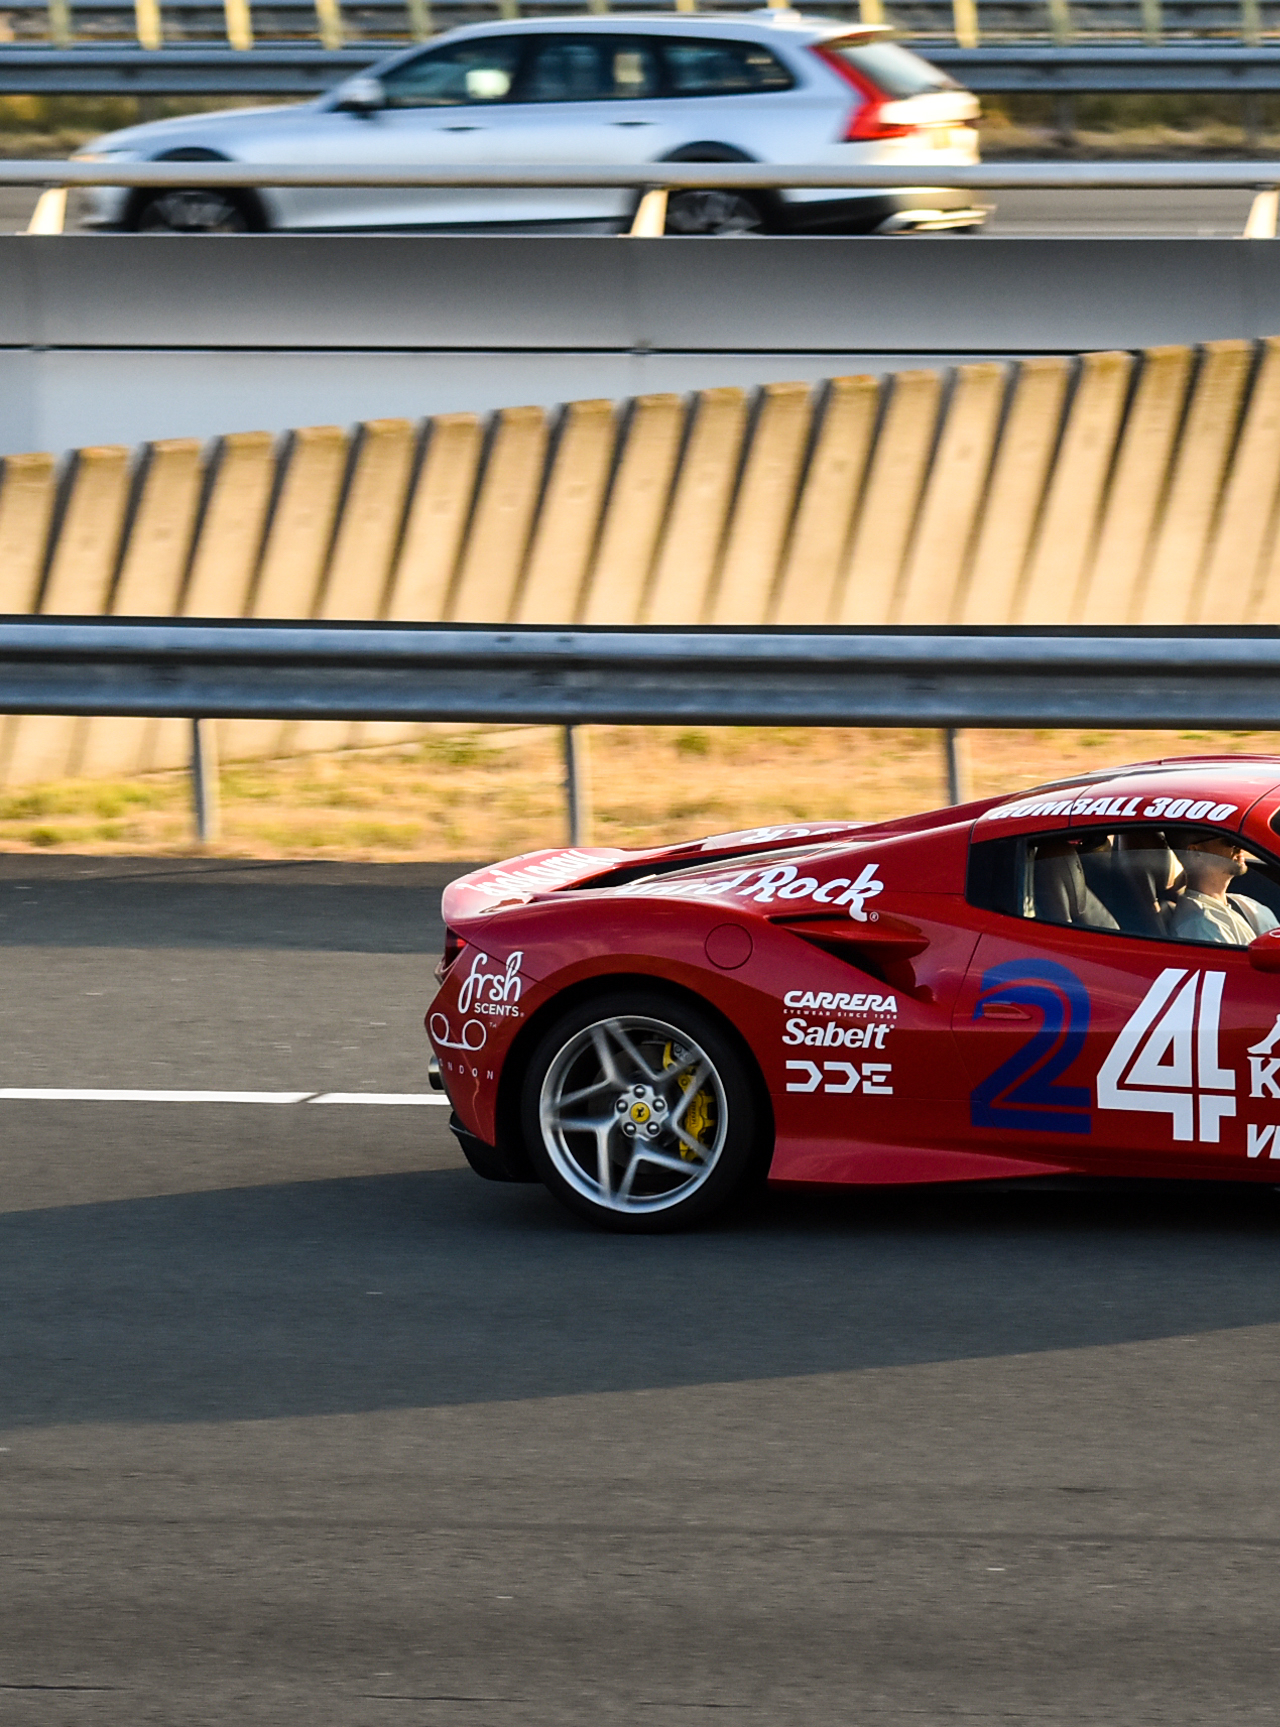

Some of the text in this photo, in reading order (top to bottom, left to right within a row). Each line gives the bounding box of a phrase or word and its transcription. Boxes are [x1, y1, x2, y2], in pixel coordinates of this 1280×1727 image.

[988, 797, 1239, 821] GUMBALL 3000
[736, 863, 885, 923] Rock
[457, 950, 525, 1014] frsh
[474, 1002, 520, 1017] SCENTS
[783, 990, 898, 1013] CARRERA
[783, 1009, 831, 1017] EYEWEAR
[782, 1017, 890, 1050] Sabelt
[968, 957, 1237, 1144] 24
[785, 1060, 893, 1095] DDE
